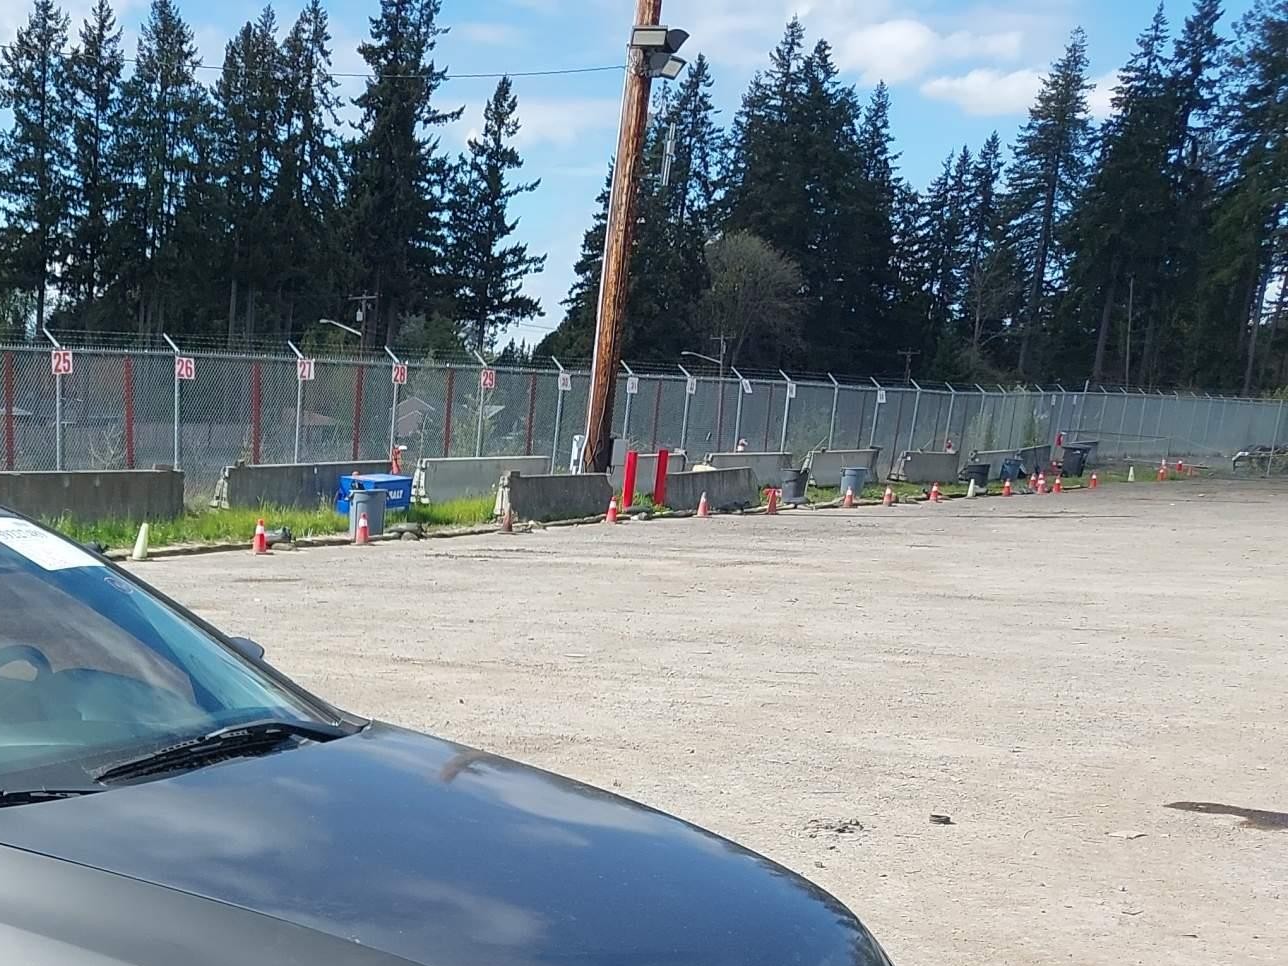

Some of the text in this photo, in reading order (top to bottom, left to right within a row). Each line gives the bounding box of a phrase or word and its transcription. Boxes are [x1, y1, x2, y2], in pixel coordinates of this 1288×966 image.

[53, 352, 71, 373] 25
[177, 359, 193, 378] 26
[299, 361, 312, 379] 27
[393, 366, 406, 383] 28
[482, 371, 494, 387] 29
